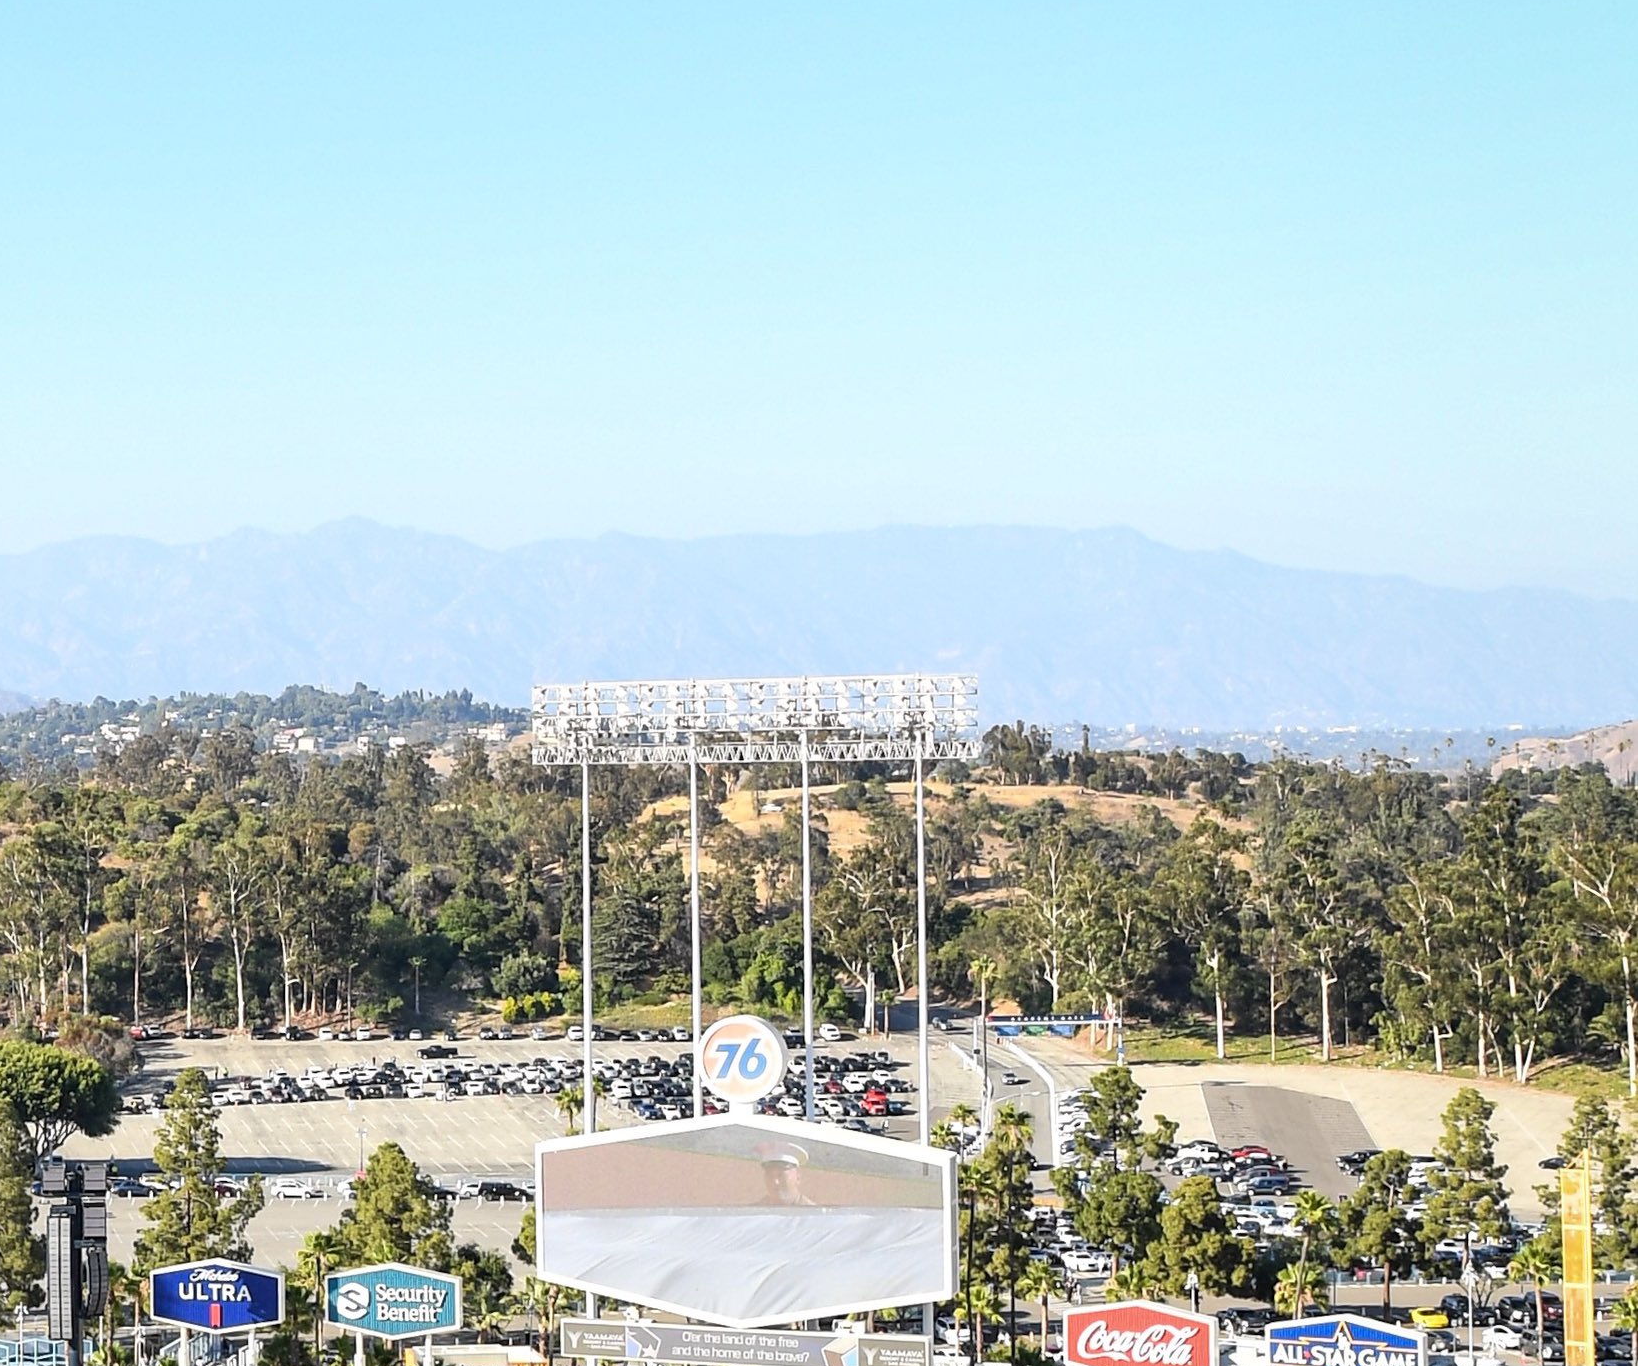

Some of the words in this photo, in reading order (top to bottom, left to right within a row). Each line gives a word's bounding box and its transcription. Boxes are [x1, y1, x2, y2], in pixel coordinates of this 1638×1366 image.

[715, 1038, 767, 1080] 76
[178, 1282, 252, 1302] ULTRA
[376, 1284, 448, 1308] Security
[376, 1302, 438, 1323] Benefit
[704, 1333, 720, 1344] the
[722, 1334, 743, 1345] land
[745, 1335, 757, 1346] of
[759, 1336, 776, 1348] the
[778, 1336, 799, 1349] free
[1076, 1319, 1200, 1366] Coca-Cola
[671, 1346, 691, 1356] and
[693, 1346, 710, 1357] the
[712, 1347, 741, 1359] home
[743, 1349, 755, 1360] of
[757, 1350, 774, 1361] the
[775, 1351, 810, 1364] brave?
[1272, 1341, 1307, 1365] ALL
